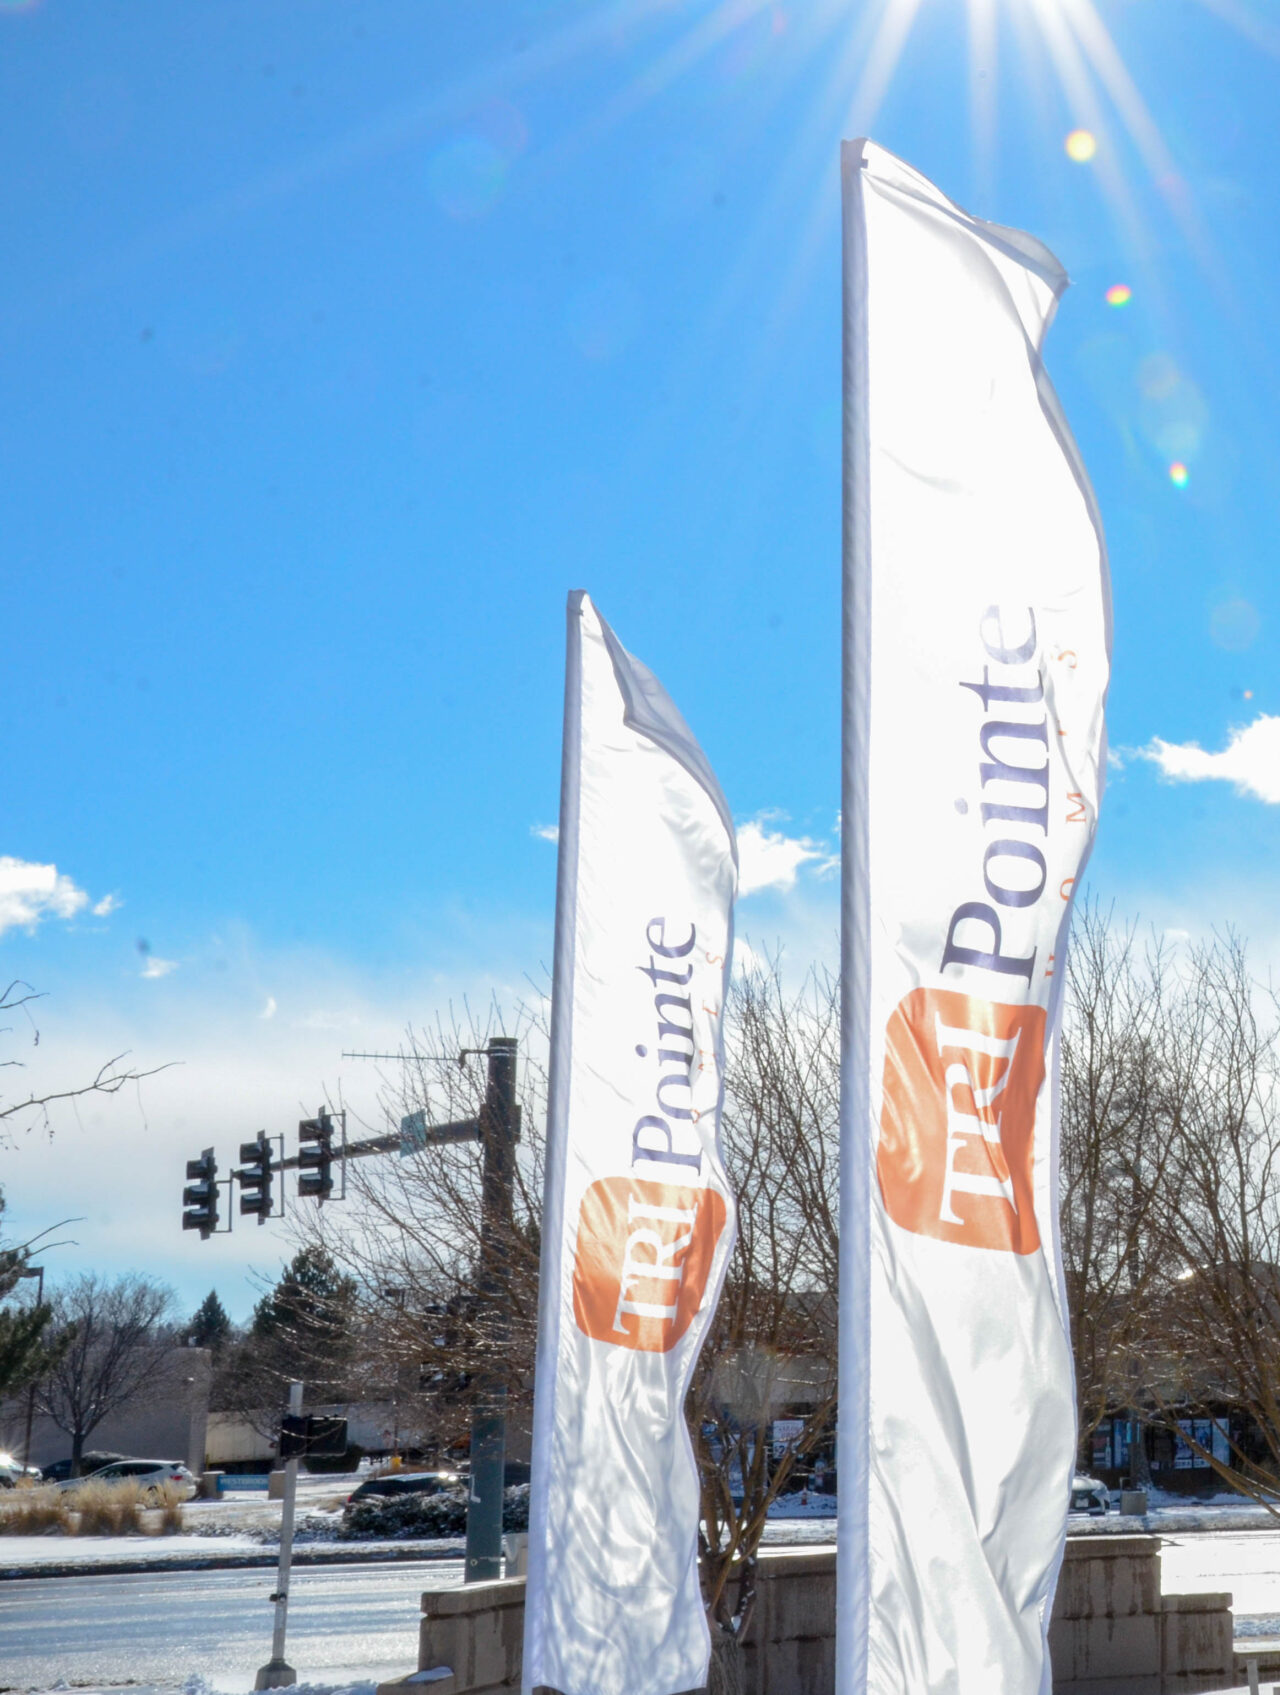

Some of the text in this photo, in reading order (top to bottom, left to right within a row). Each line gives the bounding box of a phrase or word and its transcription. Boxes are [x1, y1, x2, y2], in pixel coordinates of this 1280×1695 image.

[612, 916, 702, 1336] TRI Pointe
[934, 605, 1050, 1225] TRI Pointe
